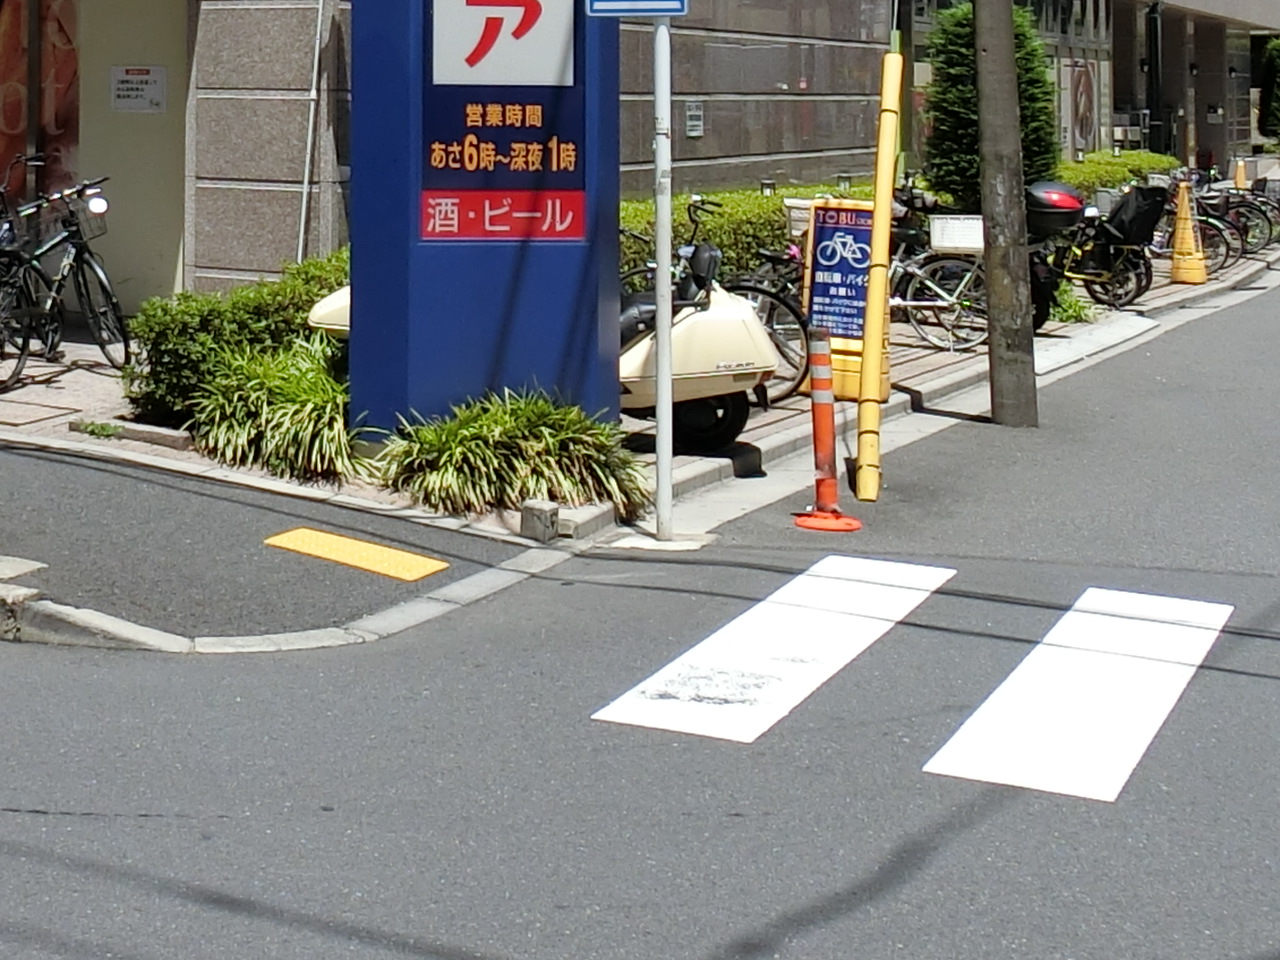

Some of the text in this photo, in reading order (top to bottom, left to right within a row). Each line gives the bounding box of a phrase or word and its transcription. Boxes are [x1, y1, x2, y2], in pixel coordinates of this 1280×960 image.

[465, 103, 543, 127] 営業時間
[426, 197, 574, 233] 酒・ビール
[816, 210, 856, 225] TOBU
